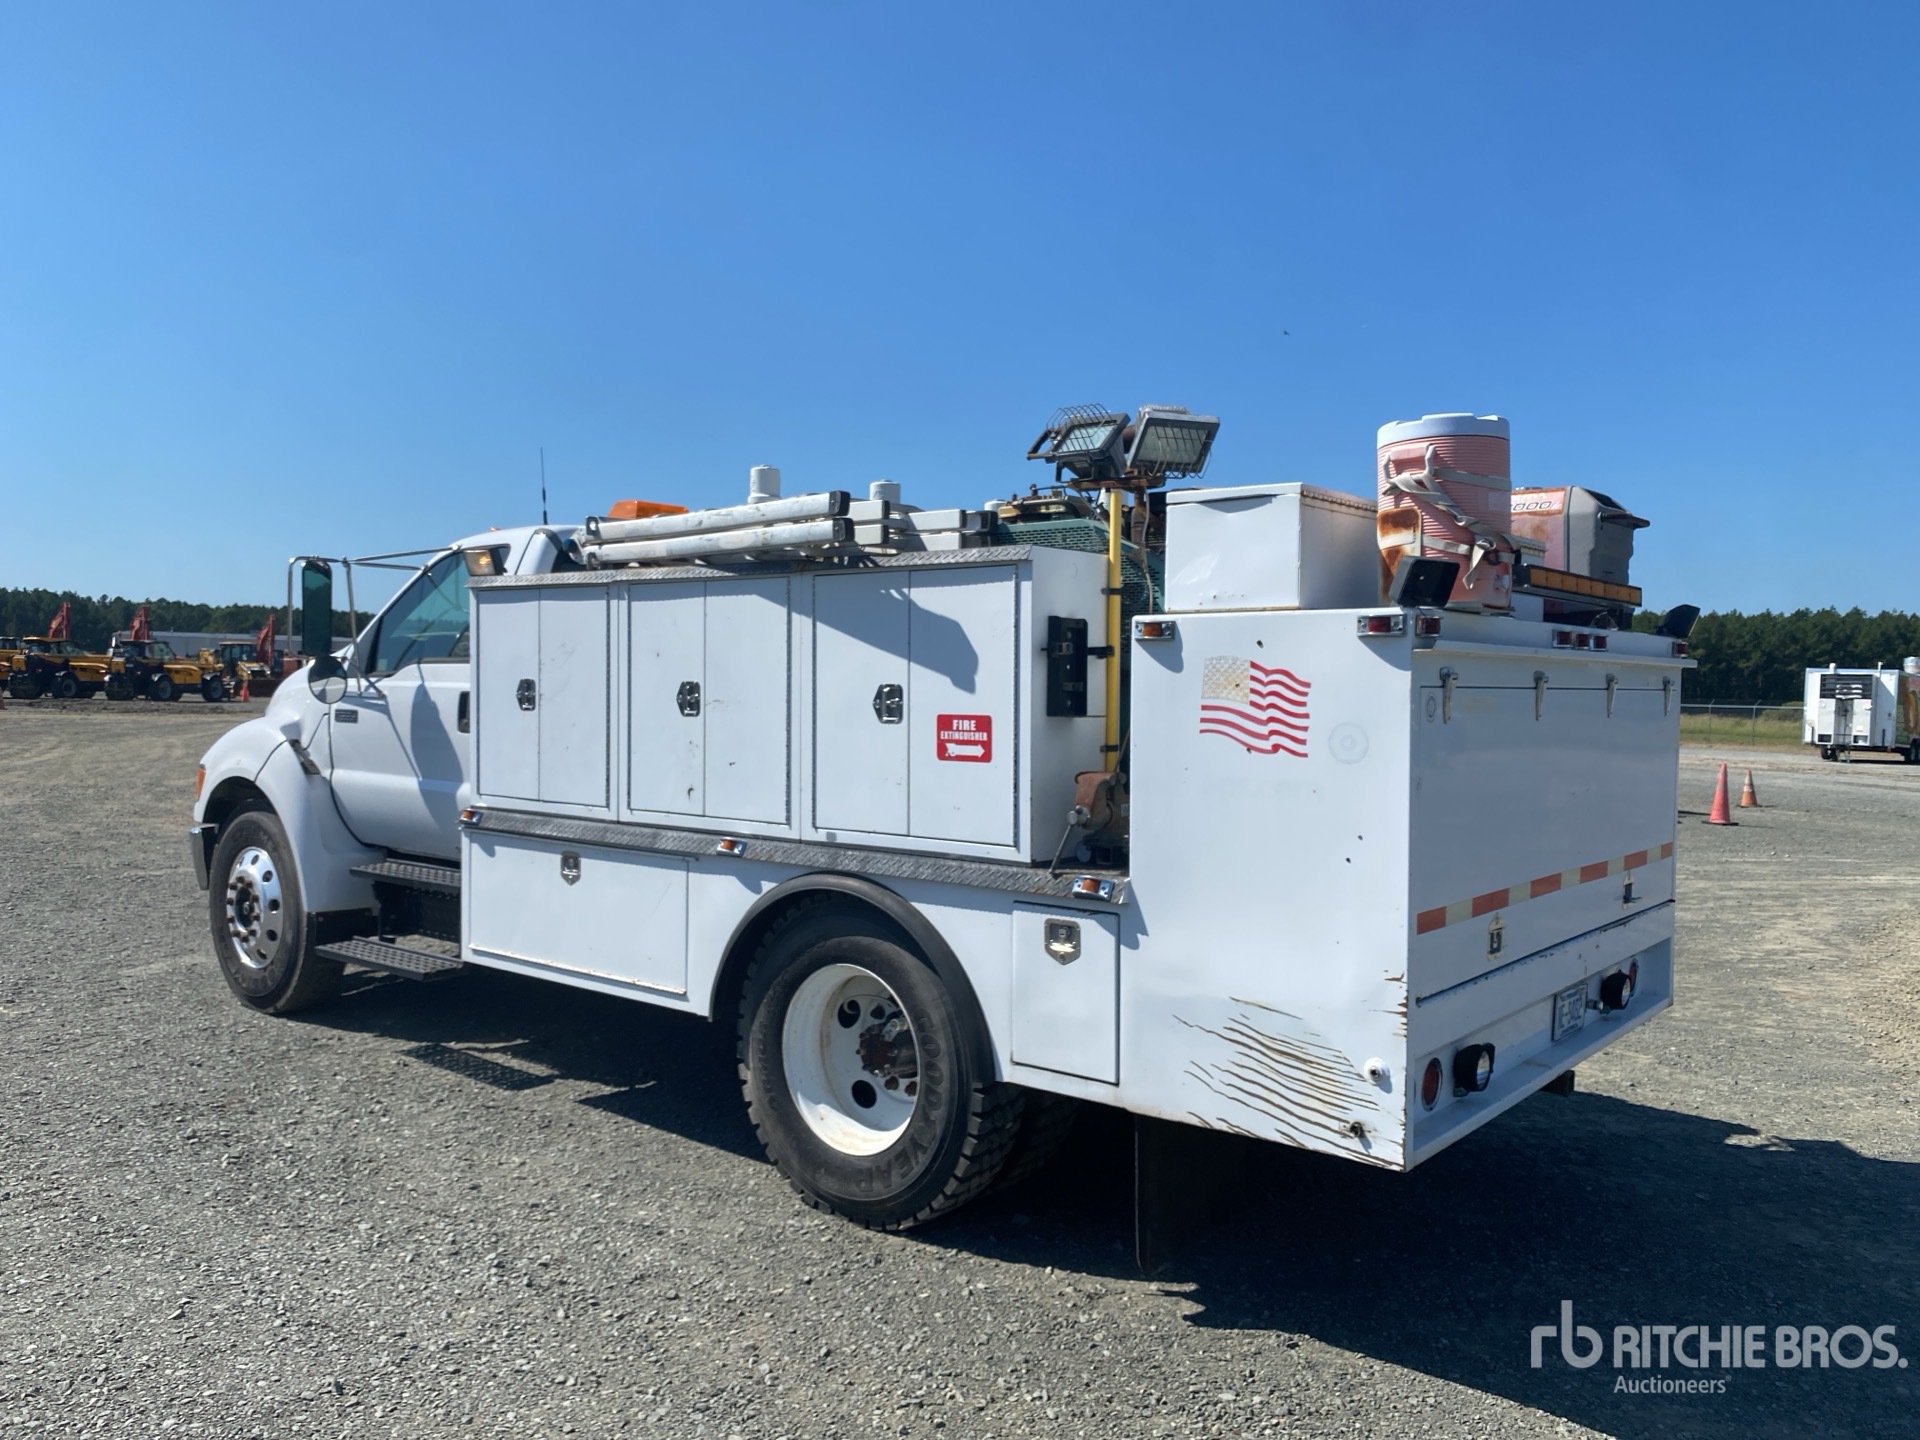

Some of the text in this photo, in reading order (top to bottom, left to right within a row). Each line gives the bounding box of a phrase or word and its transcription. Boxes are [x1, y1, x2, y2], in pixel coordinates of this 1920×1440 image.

[1511, 501, 1552, 511] 000
[952, 719, 977, 731] FIRE
[940, 731, 988, 741] EXTINGUISHER
[853, 1007, 944, 1192] GOODYEAR
